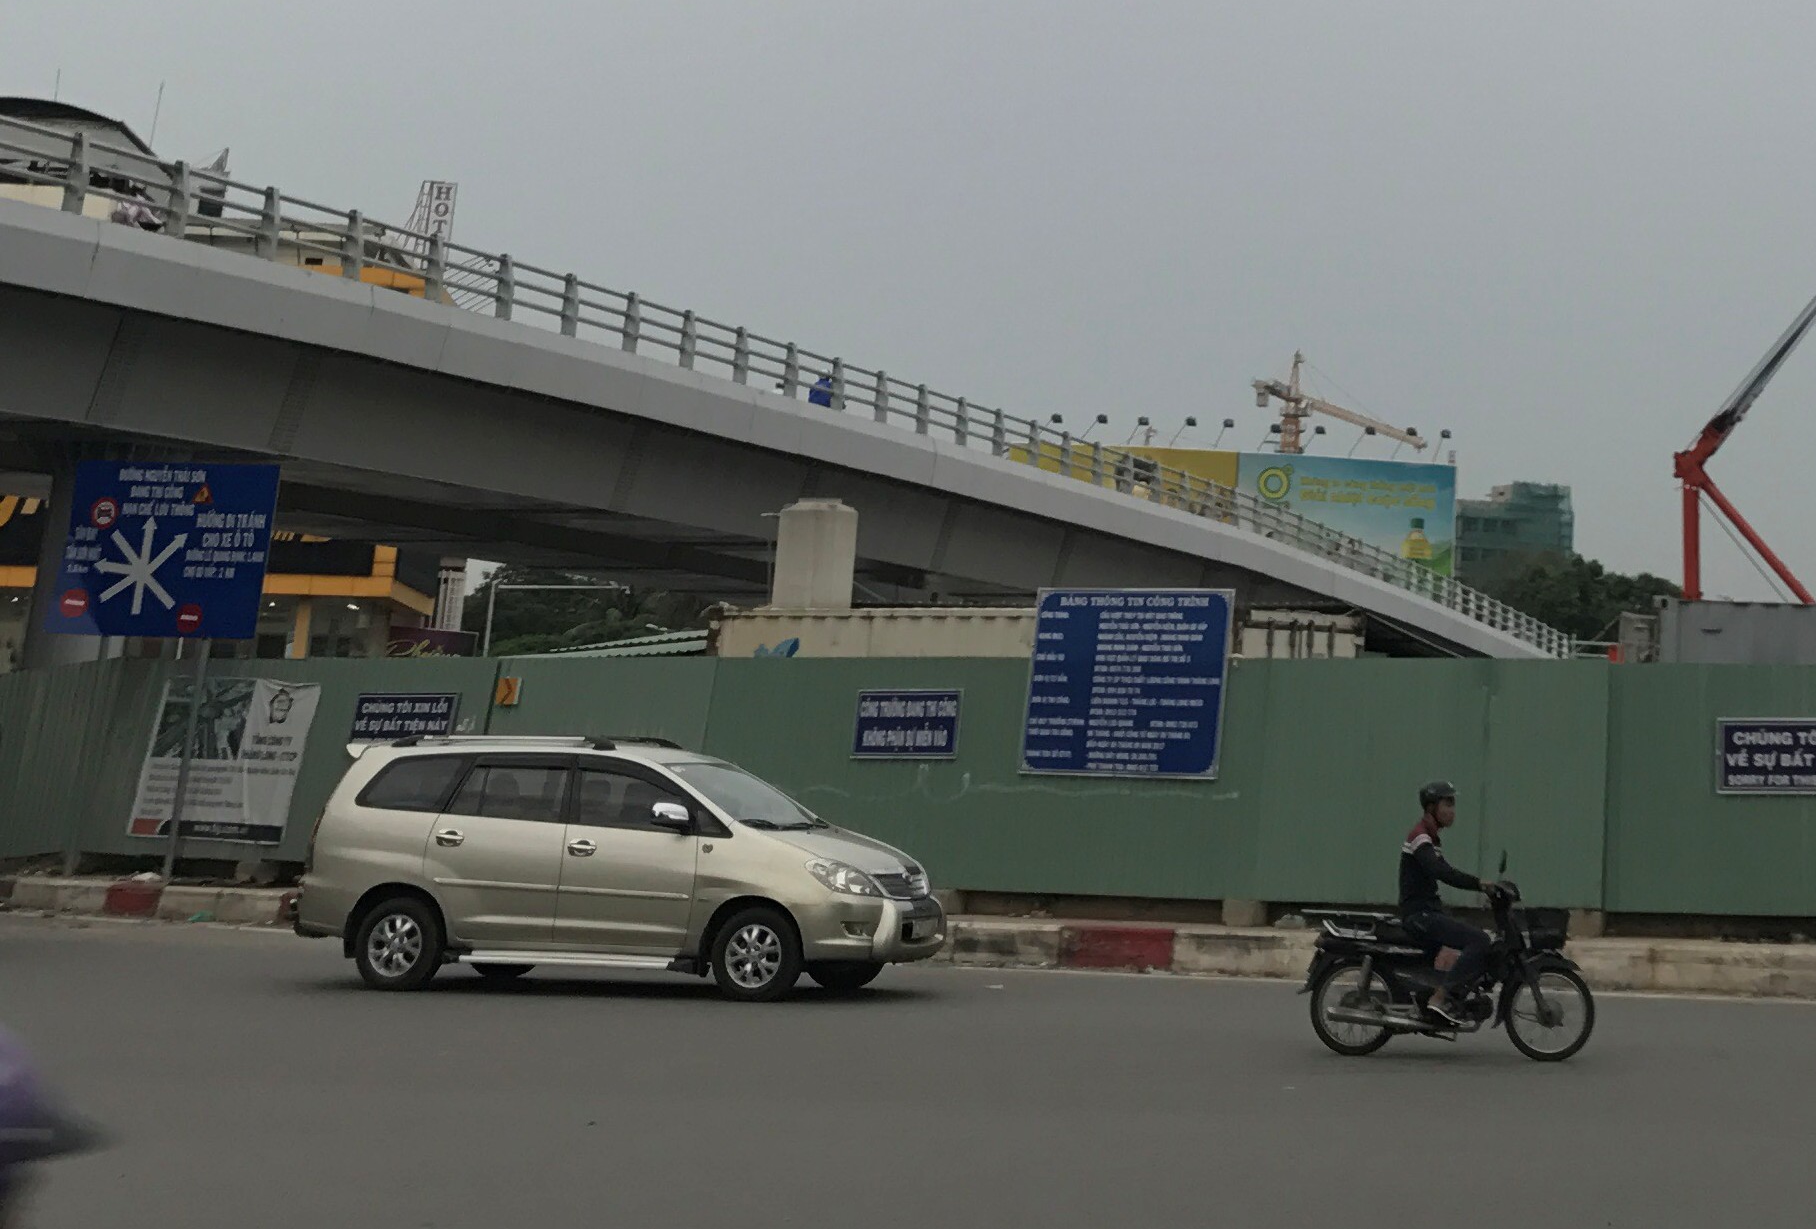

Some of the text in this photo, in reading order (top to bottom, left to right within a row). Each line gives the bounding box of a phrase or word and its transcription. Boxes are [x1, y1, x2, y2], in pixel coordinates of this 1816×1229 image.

[1091, 594, 1124, 606] THÔNG
[1127, 596, 1144, 606] TIN
[1146, 594, 1174, 607] CÔNG
[362, 699, 394, 713] CHÚNG
[396, 700, 412, 713] TÔI
[414, 702, 431, 713] XIN
[1732, 728, 1794, 746] CHÚNG
[1753, 750, 1777, 771] SỰ
[1780, 748, 1815, 767] BẤT
